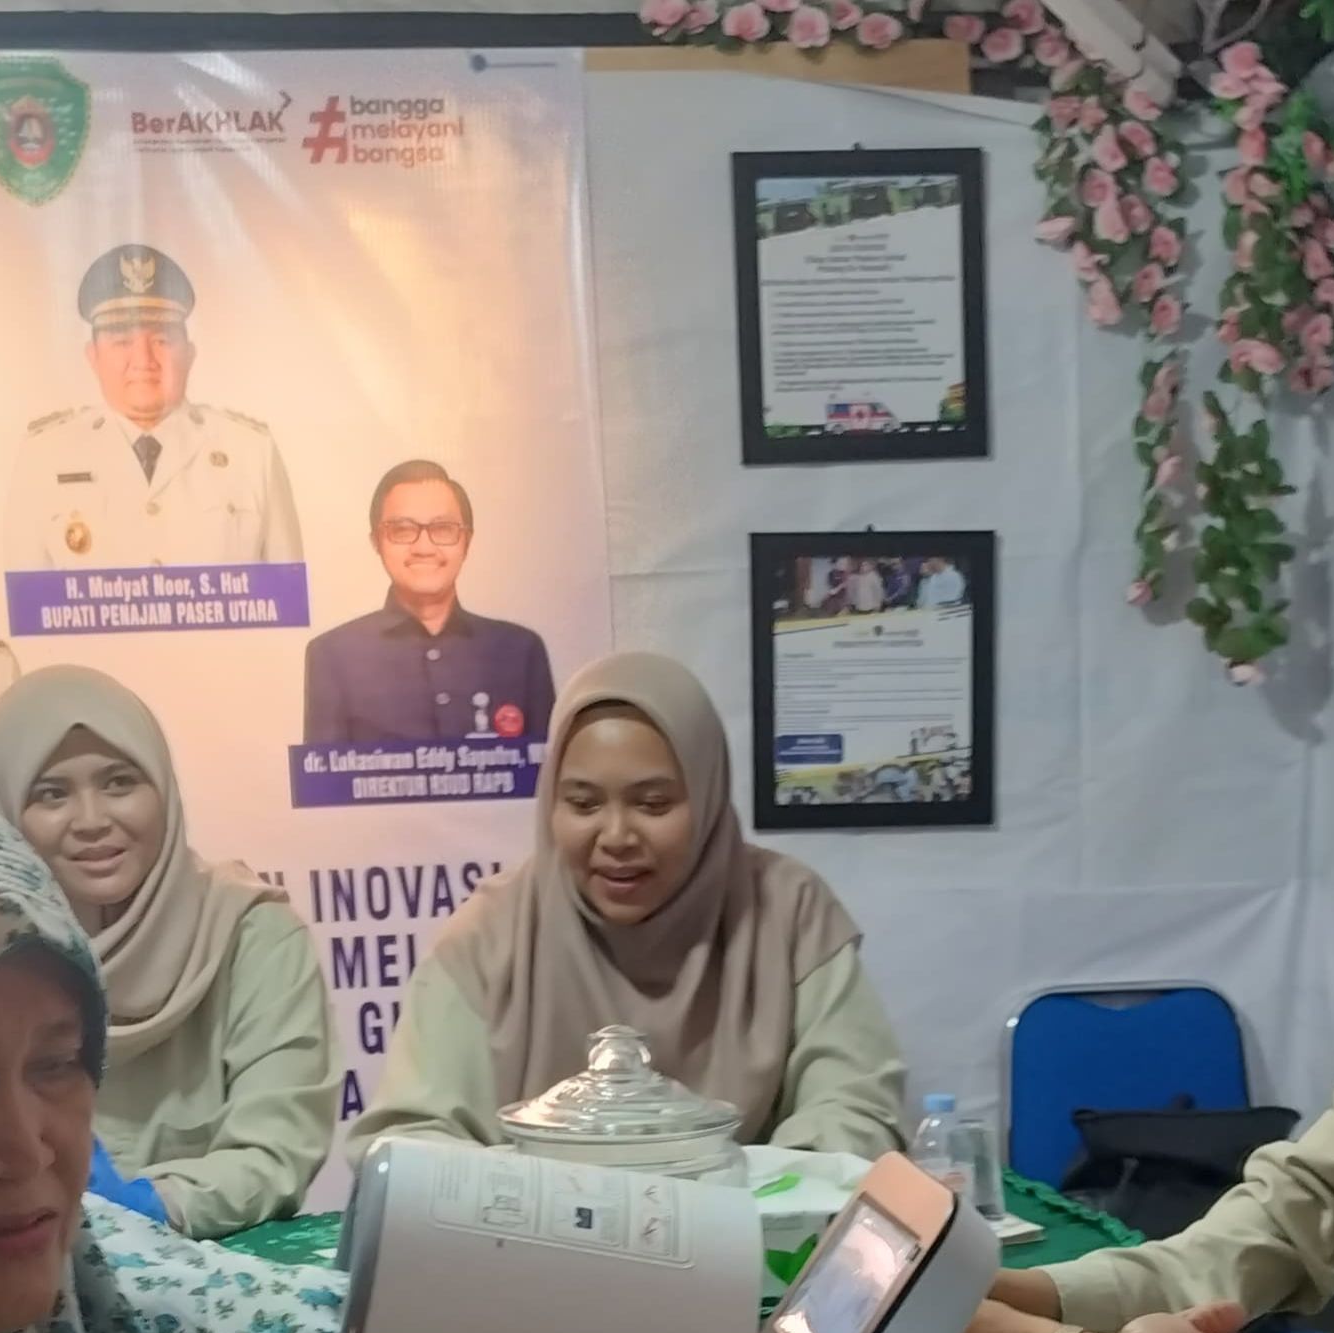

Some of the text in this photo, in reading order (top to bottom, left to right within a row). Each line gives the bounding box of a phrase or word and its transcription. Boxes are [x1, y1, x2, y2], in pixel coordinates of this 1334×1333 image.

[349, 95, 445, 120] bangga
[352, 116, 464, 142] melayani
[352, 145, 446, 168] bangsa
[65, 572, 249, 602] H. Mudyat Noor, S. Hut
[41, 599, 278, 629] BUPATI PENAJAM PASER UTARA
[310, 862, 501, 923] INOVAS
